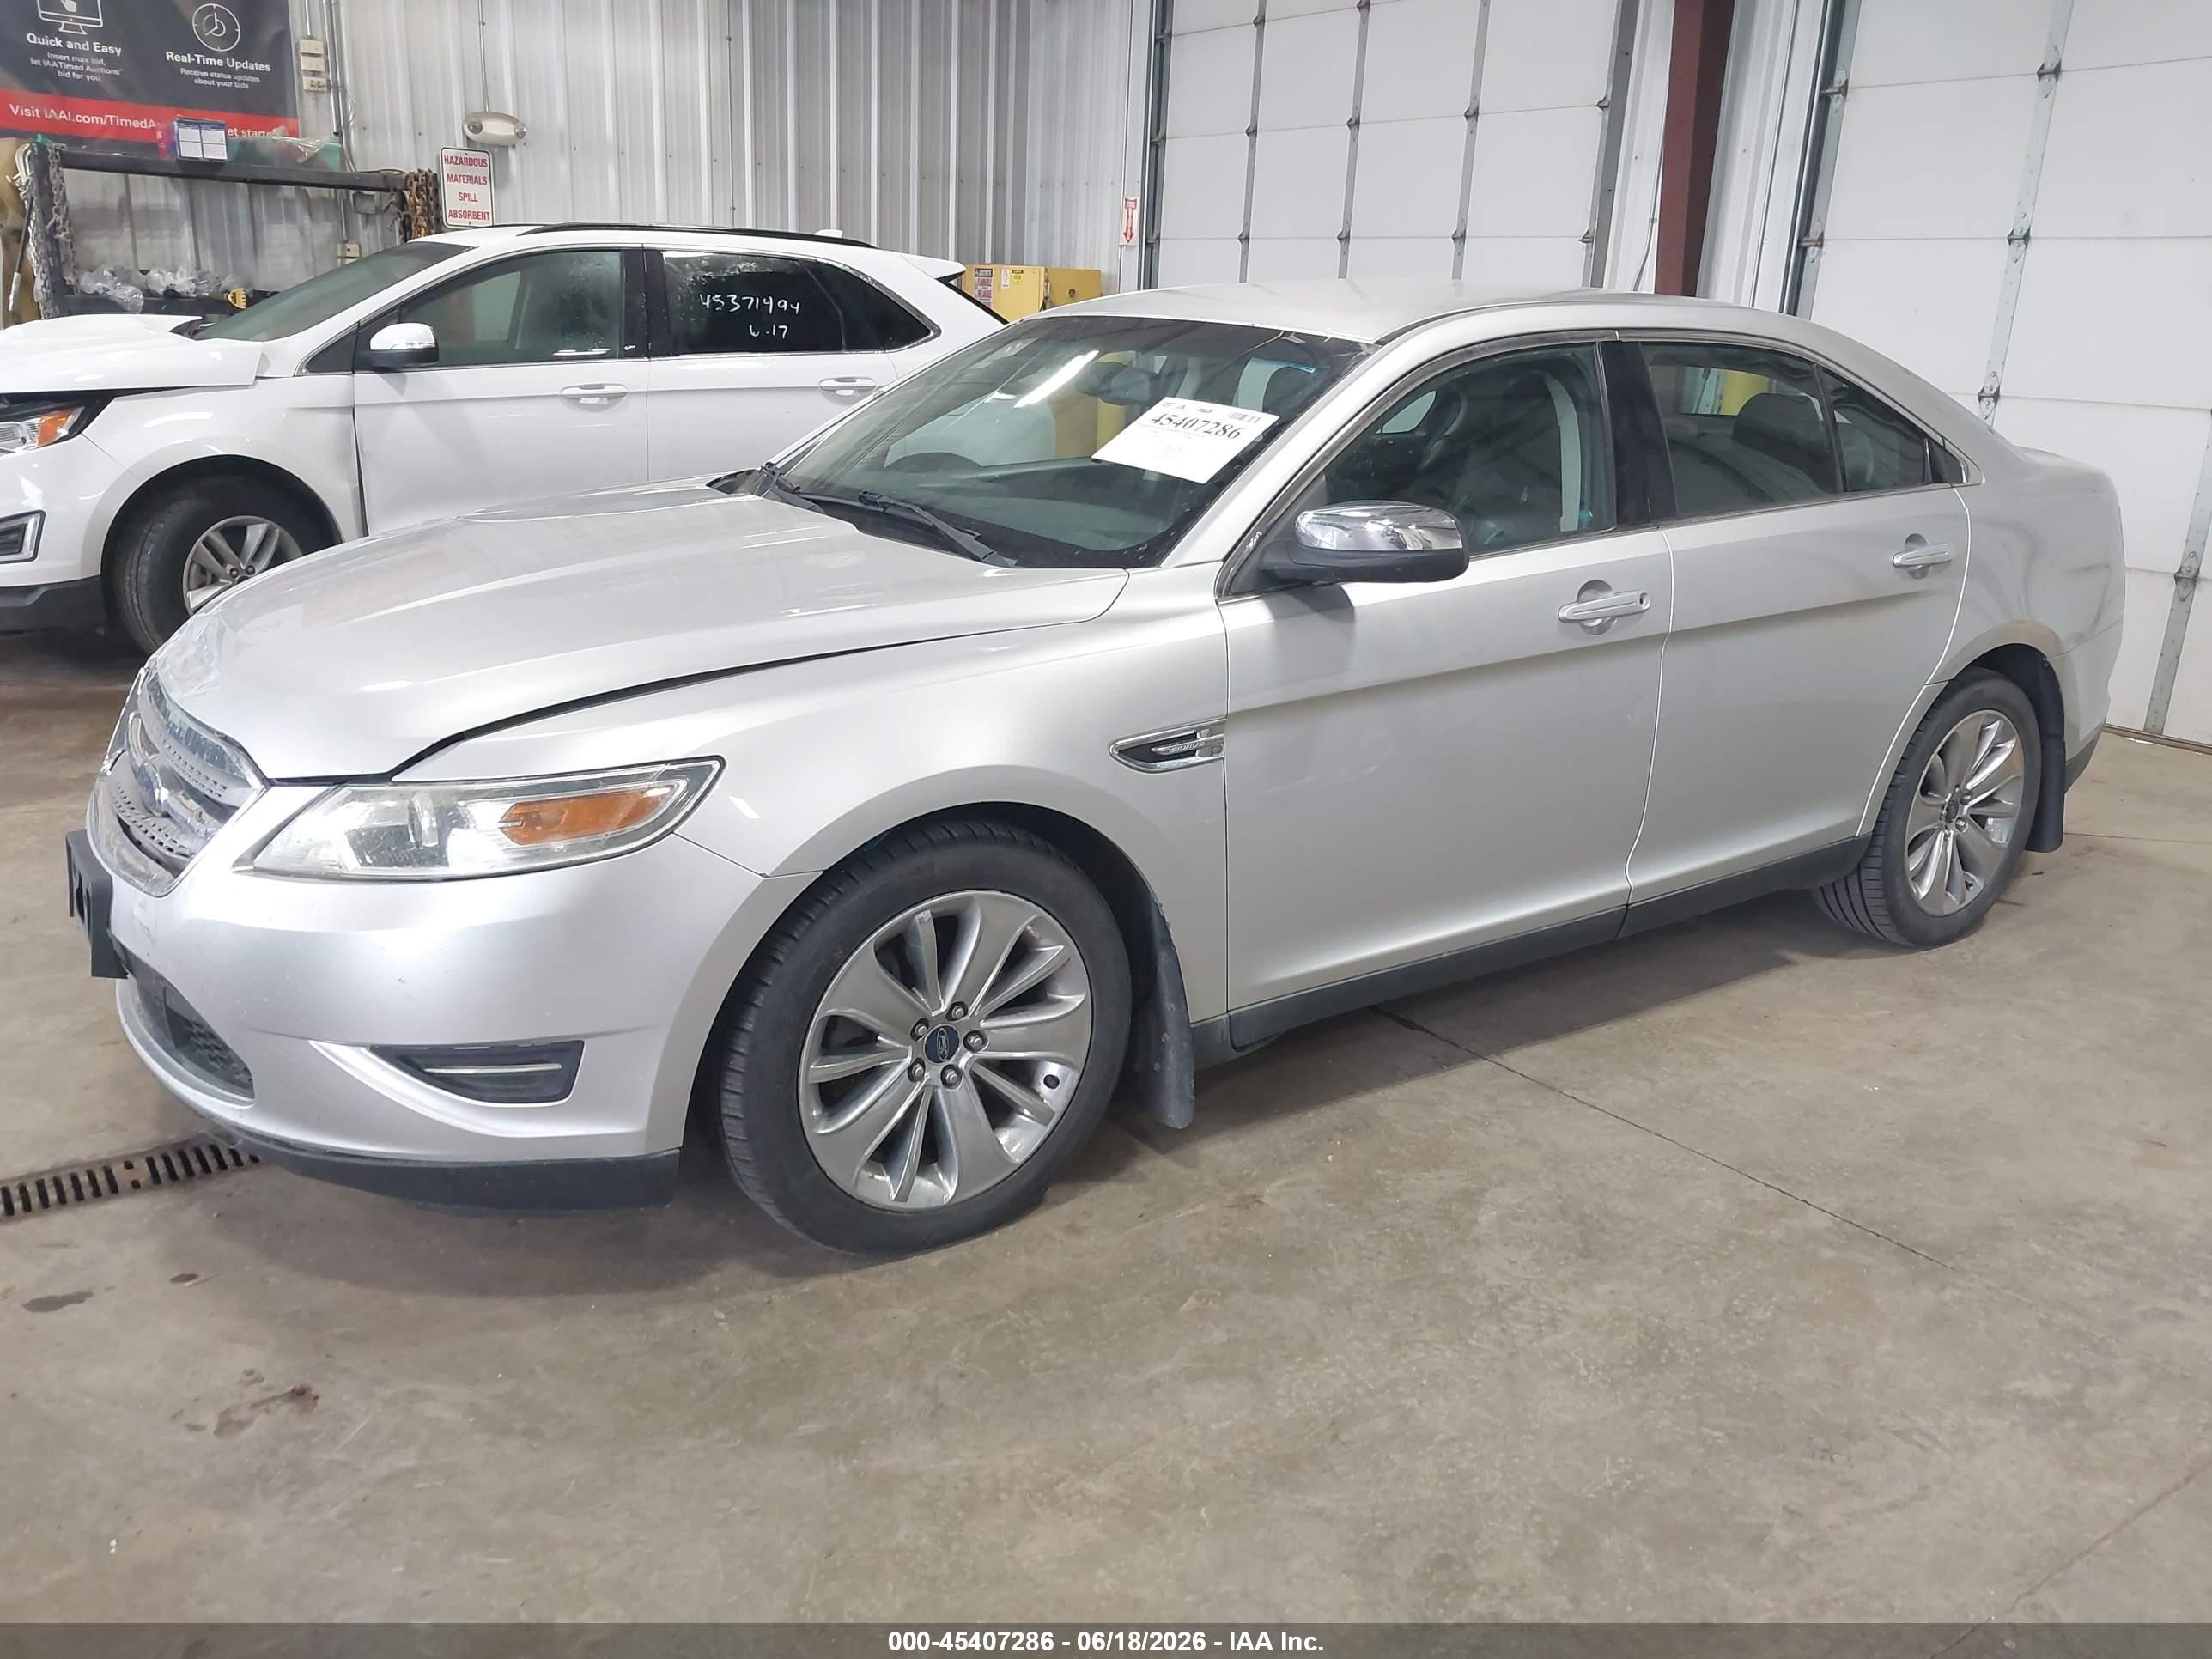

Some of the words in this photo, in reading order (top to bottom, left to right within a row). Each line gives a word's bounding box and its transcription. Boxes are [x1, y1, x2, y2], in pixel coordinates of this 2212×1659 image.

[27, 33, 64, 48] Quick
[66, 40, 89, 51] and
[93, 41, 122, 57] Easy
[47, 52, 70, 61] Insert
[165, 51, 223, 67] Real-Time
[226, 58, 271, 72] Updates
[58, 61, 84, 71] Timed
[72, 71, 83, 80] for
[193, 77, 216, 86] about
[9, 103, 40, 118] Visit
[44, 108, 159, 129] IAAI.com/TimedA
[228, 128, 239, 137] et
[444, 155, 488, 167] HAZARDOUS
[447, 173, 488, 185] MATERIALS
[458, 191, 478, 203] SPILL
[447, 209, 490, 221] ABSORBENT
[699, 293, 800, 315] 45371494
[1151, 413, 1243, 439] 45407286
